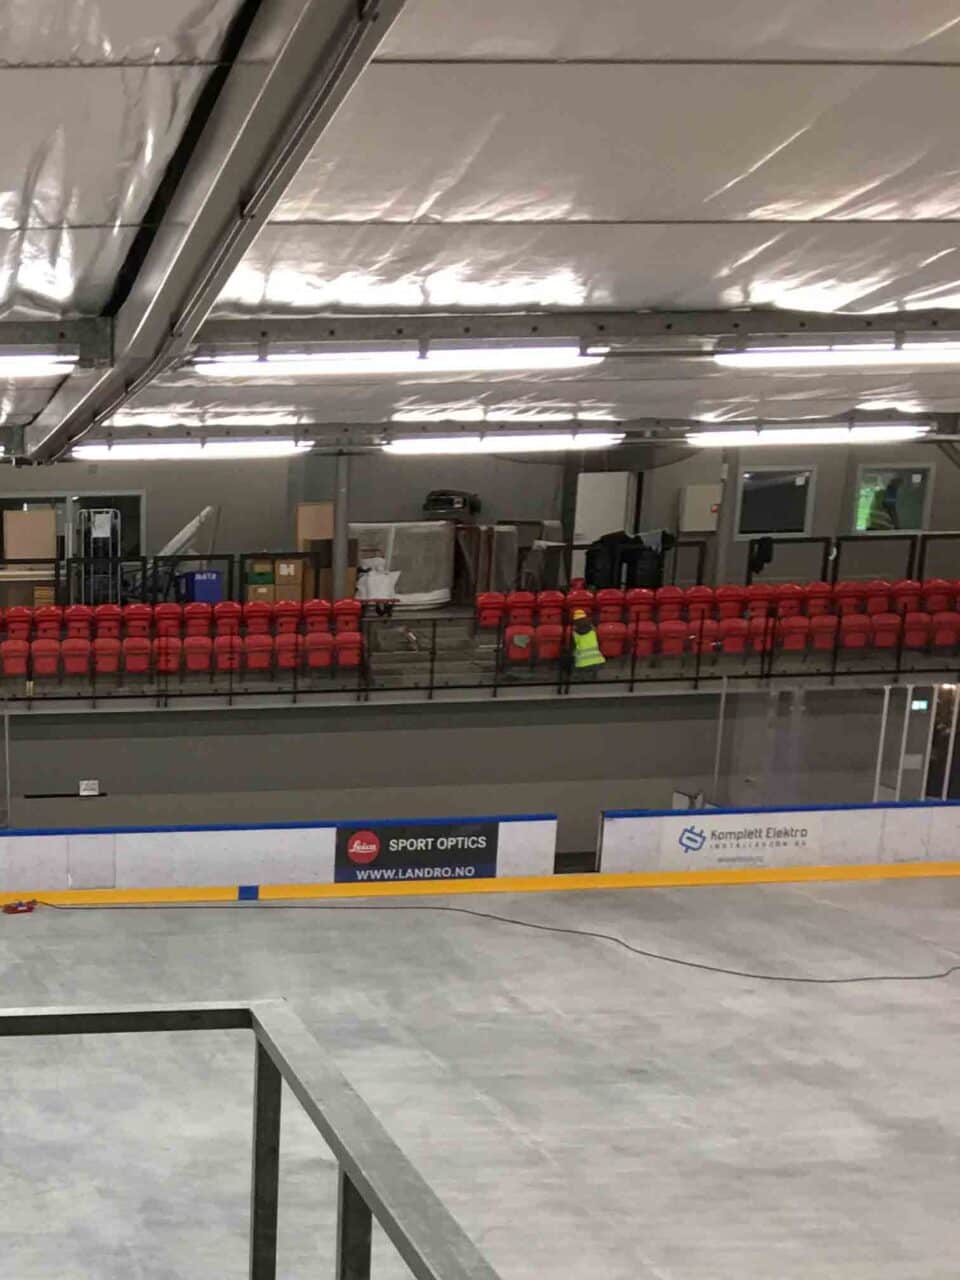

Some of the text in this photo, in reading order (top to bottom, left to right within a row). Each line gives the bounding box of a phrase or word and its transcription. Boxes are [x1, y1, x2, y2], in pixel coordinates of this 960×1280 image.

[711, 827, 808, 840] Komplett Elektro
[348, 840, 377, 854] Leica
[389, 836, 487, 851] SPORT OPTICS
[356, 866, 476, 880] WWW.LANDRO.NO
